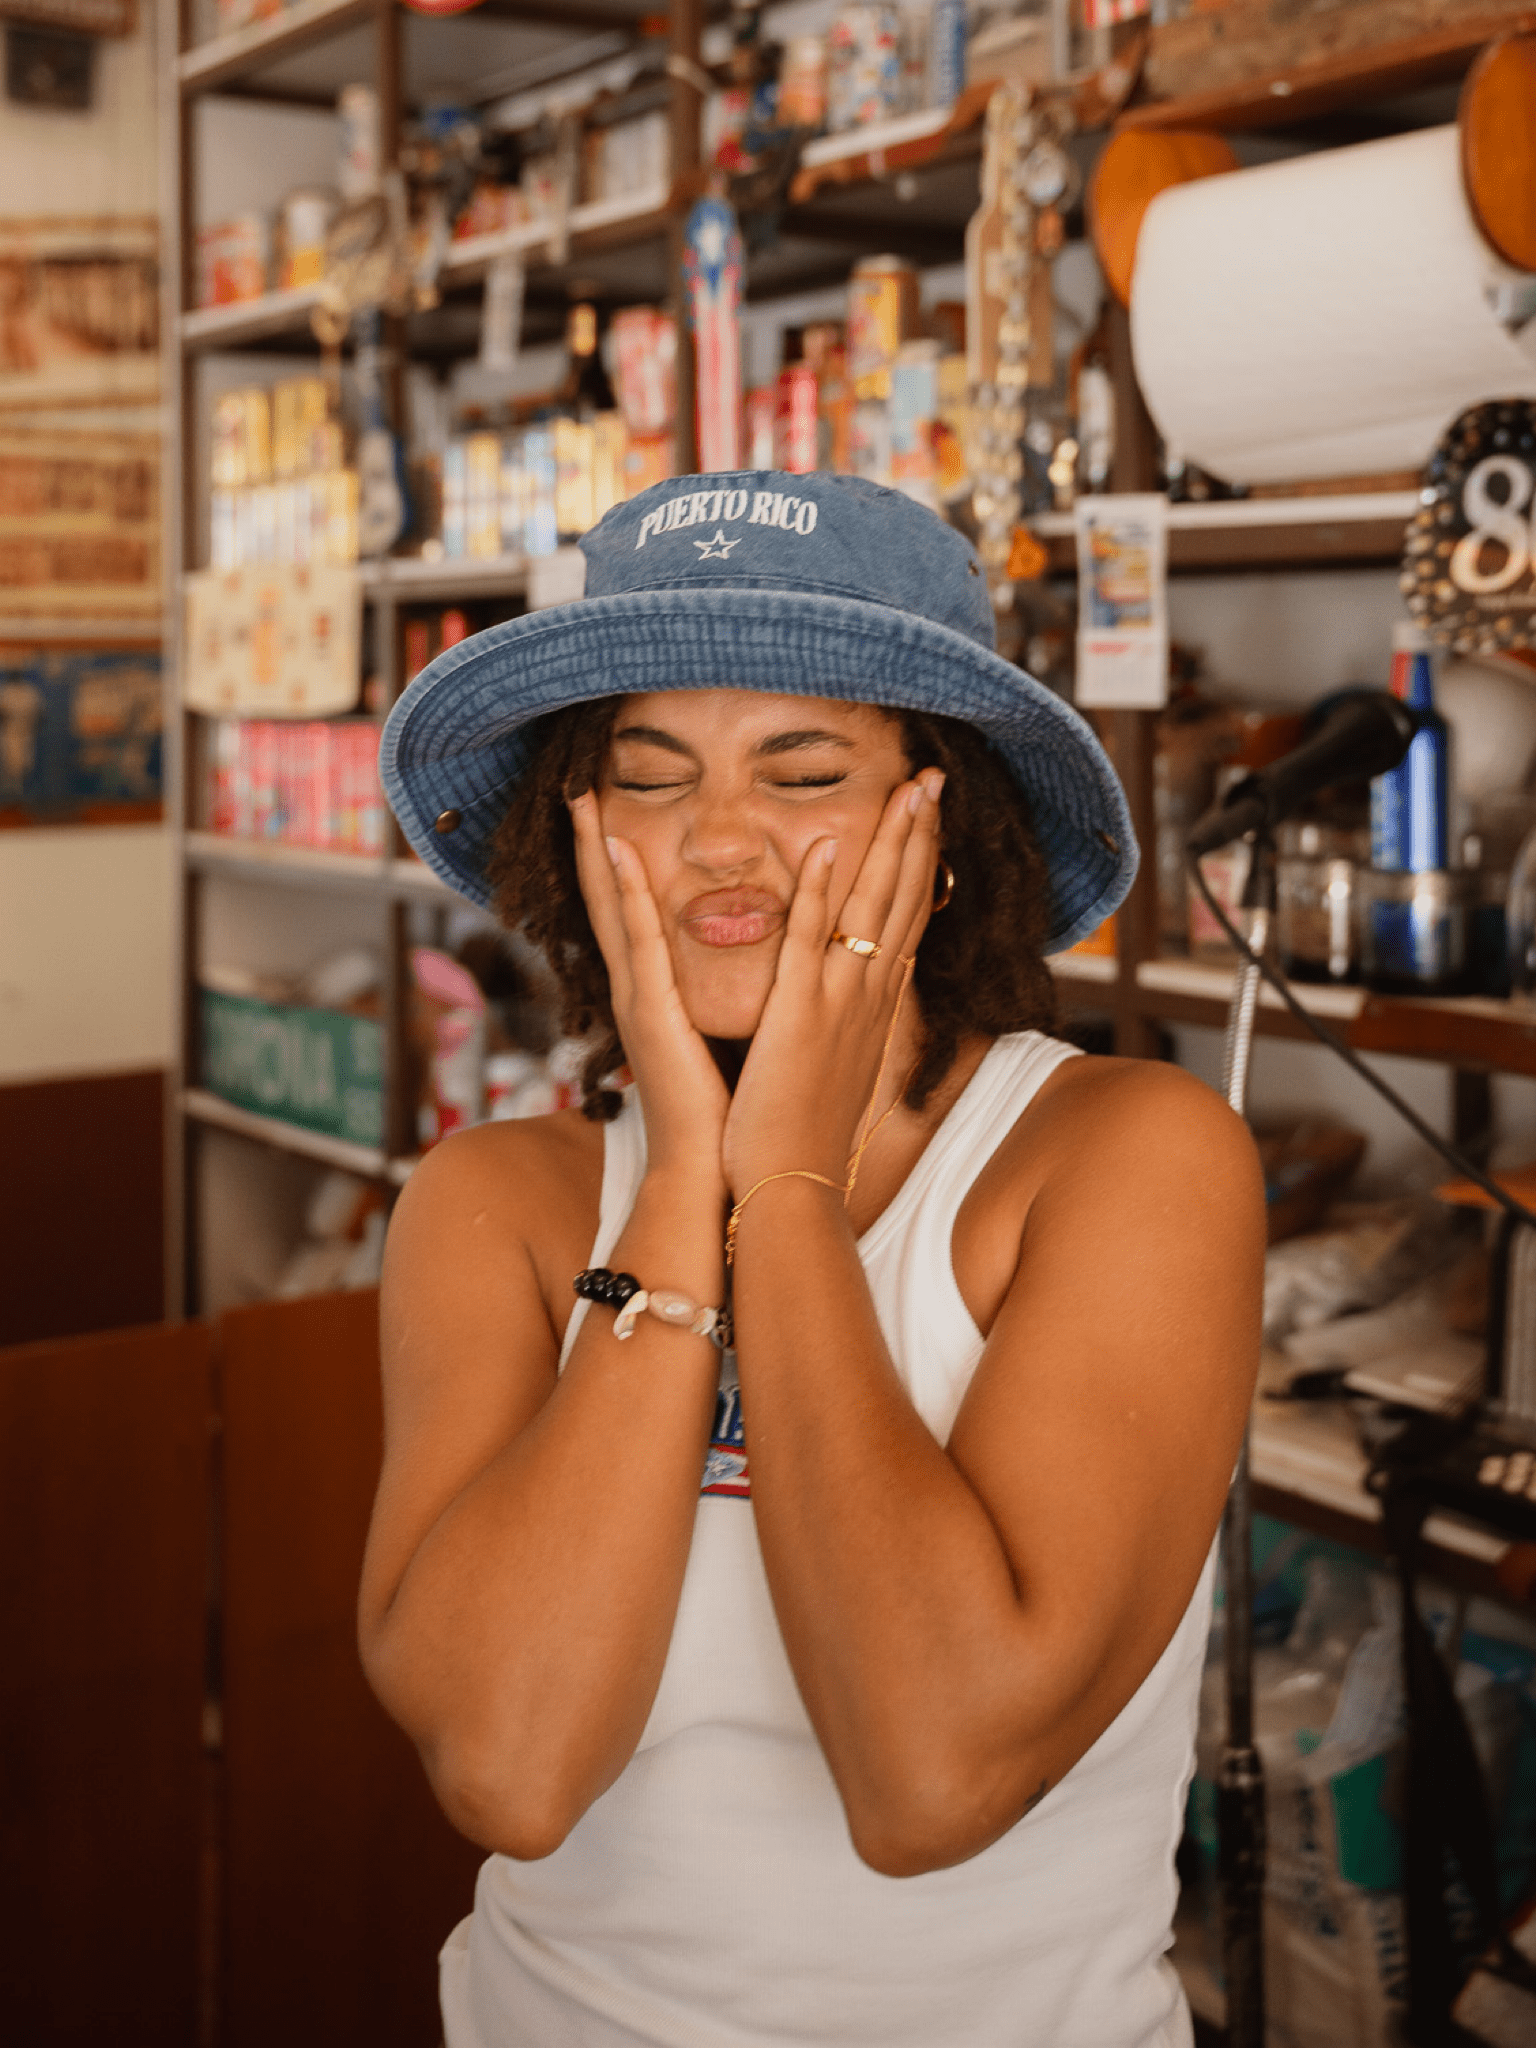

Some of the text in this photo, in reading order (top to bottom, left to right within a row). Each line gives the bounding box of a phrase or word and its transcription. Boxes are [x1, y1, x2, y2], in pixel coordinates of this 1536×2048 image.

[635, 489, 818, 550] PUERTO RICO
[1451, 455, 1536, 593] 8
